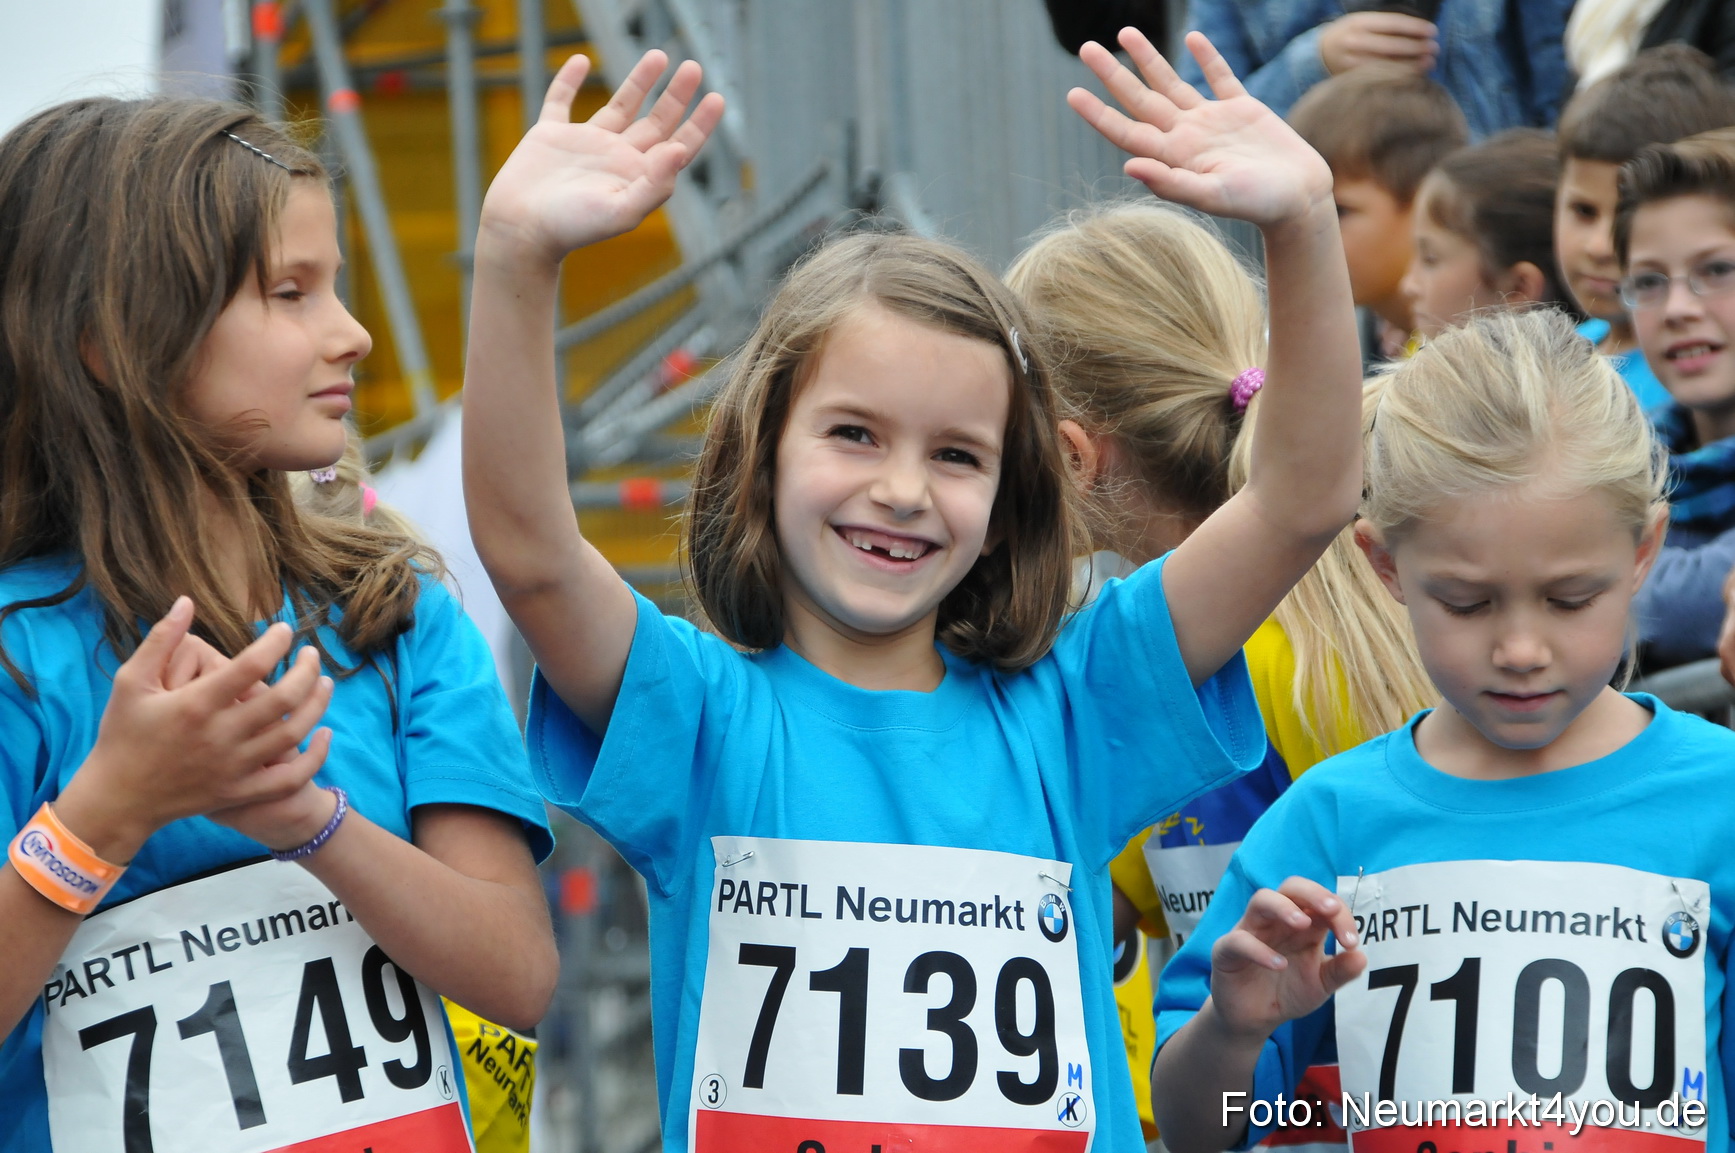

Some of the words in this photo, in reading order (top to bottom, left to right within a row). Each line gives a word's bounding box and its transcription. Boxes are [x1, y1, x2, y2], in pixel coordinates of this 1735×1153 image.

[26, 836, 99, 894] MUCOSOLVAN
[717, 879, 822, 919] PARTL
[836, 886, 1025, 931] Neumarkt
[1453, 901, 1648, 943] Neumarkt
[44, 942, 173, 1015] PARTL
[179, 900, 354, 963] Neumar
[78, 944, 433, 1153] 7149
[738, 943, 1059, 1106] 7139
[1368, 957, 1676, 1110] 7100
[440, 1070, 451, 1095] K
[708, 1079, 719, 1104] 3
[1068, 1062, 1082, 1090] M
[1682, 1067, 1704, 1102] M
